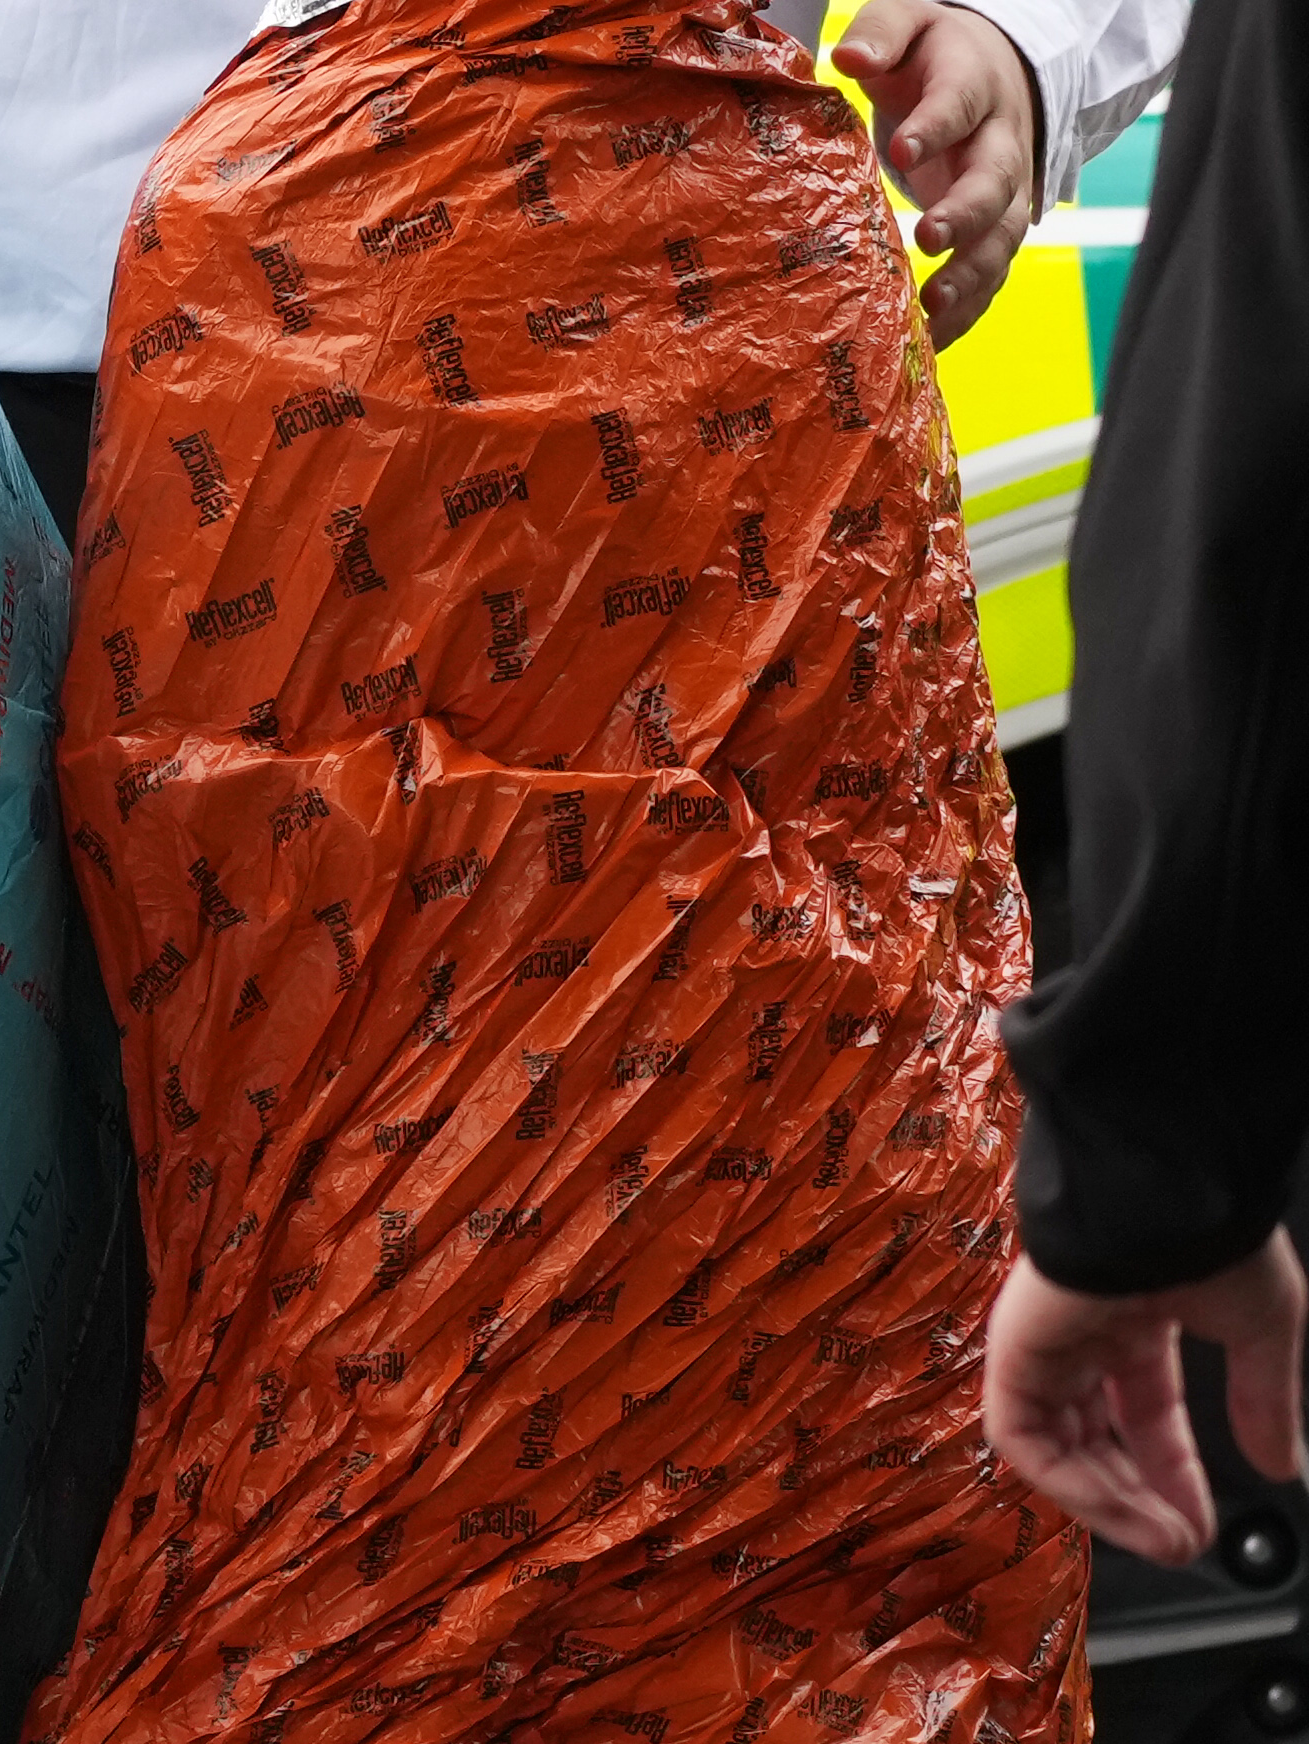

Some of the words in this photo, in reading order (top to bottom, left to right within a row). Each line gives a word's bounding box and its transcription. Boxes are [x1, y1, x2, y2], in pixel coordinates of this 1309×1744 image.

[272, 382, 365, 450] Reflexcell
[443, 471, 528, 528] Reflexcell
[186, 579, 276, 642] Reflexcell
[604, 574, 690, 628] Reflexcell
[481, 589, 527, 684] Reflexcell
[340, 656, 419, 716] Reflexcell
[554, 791, 585, 883] Reflexcell
